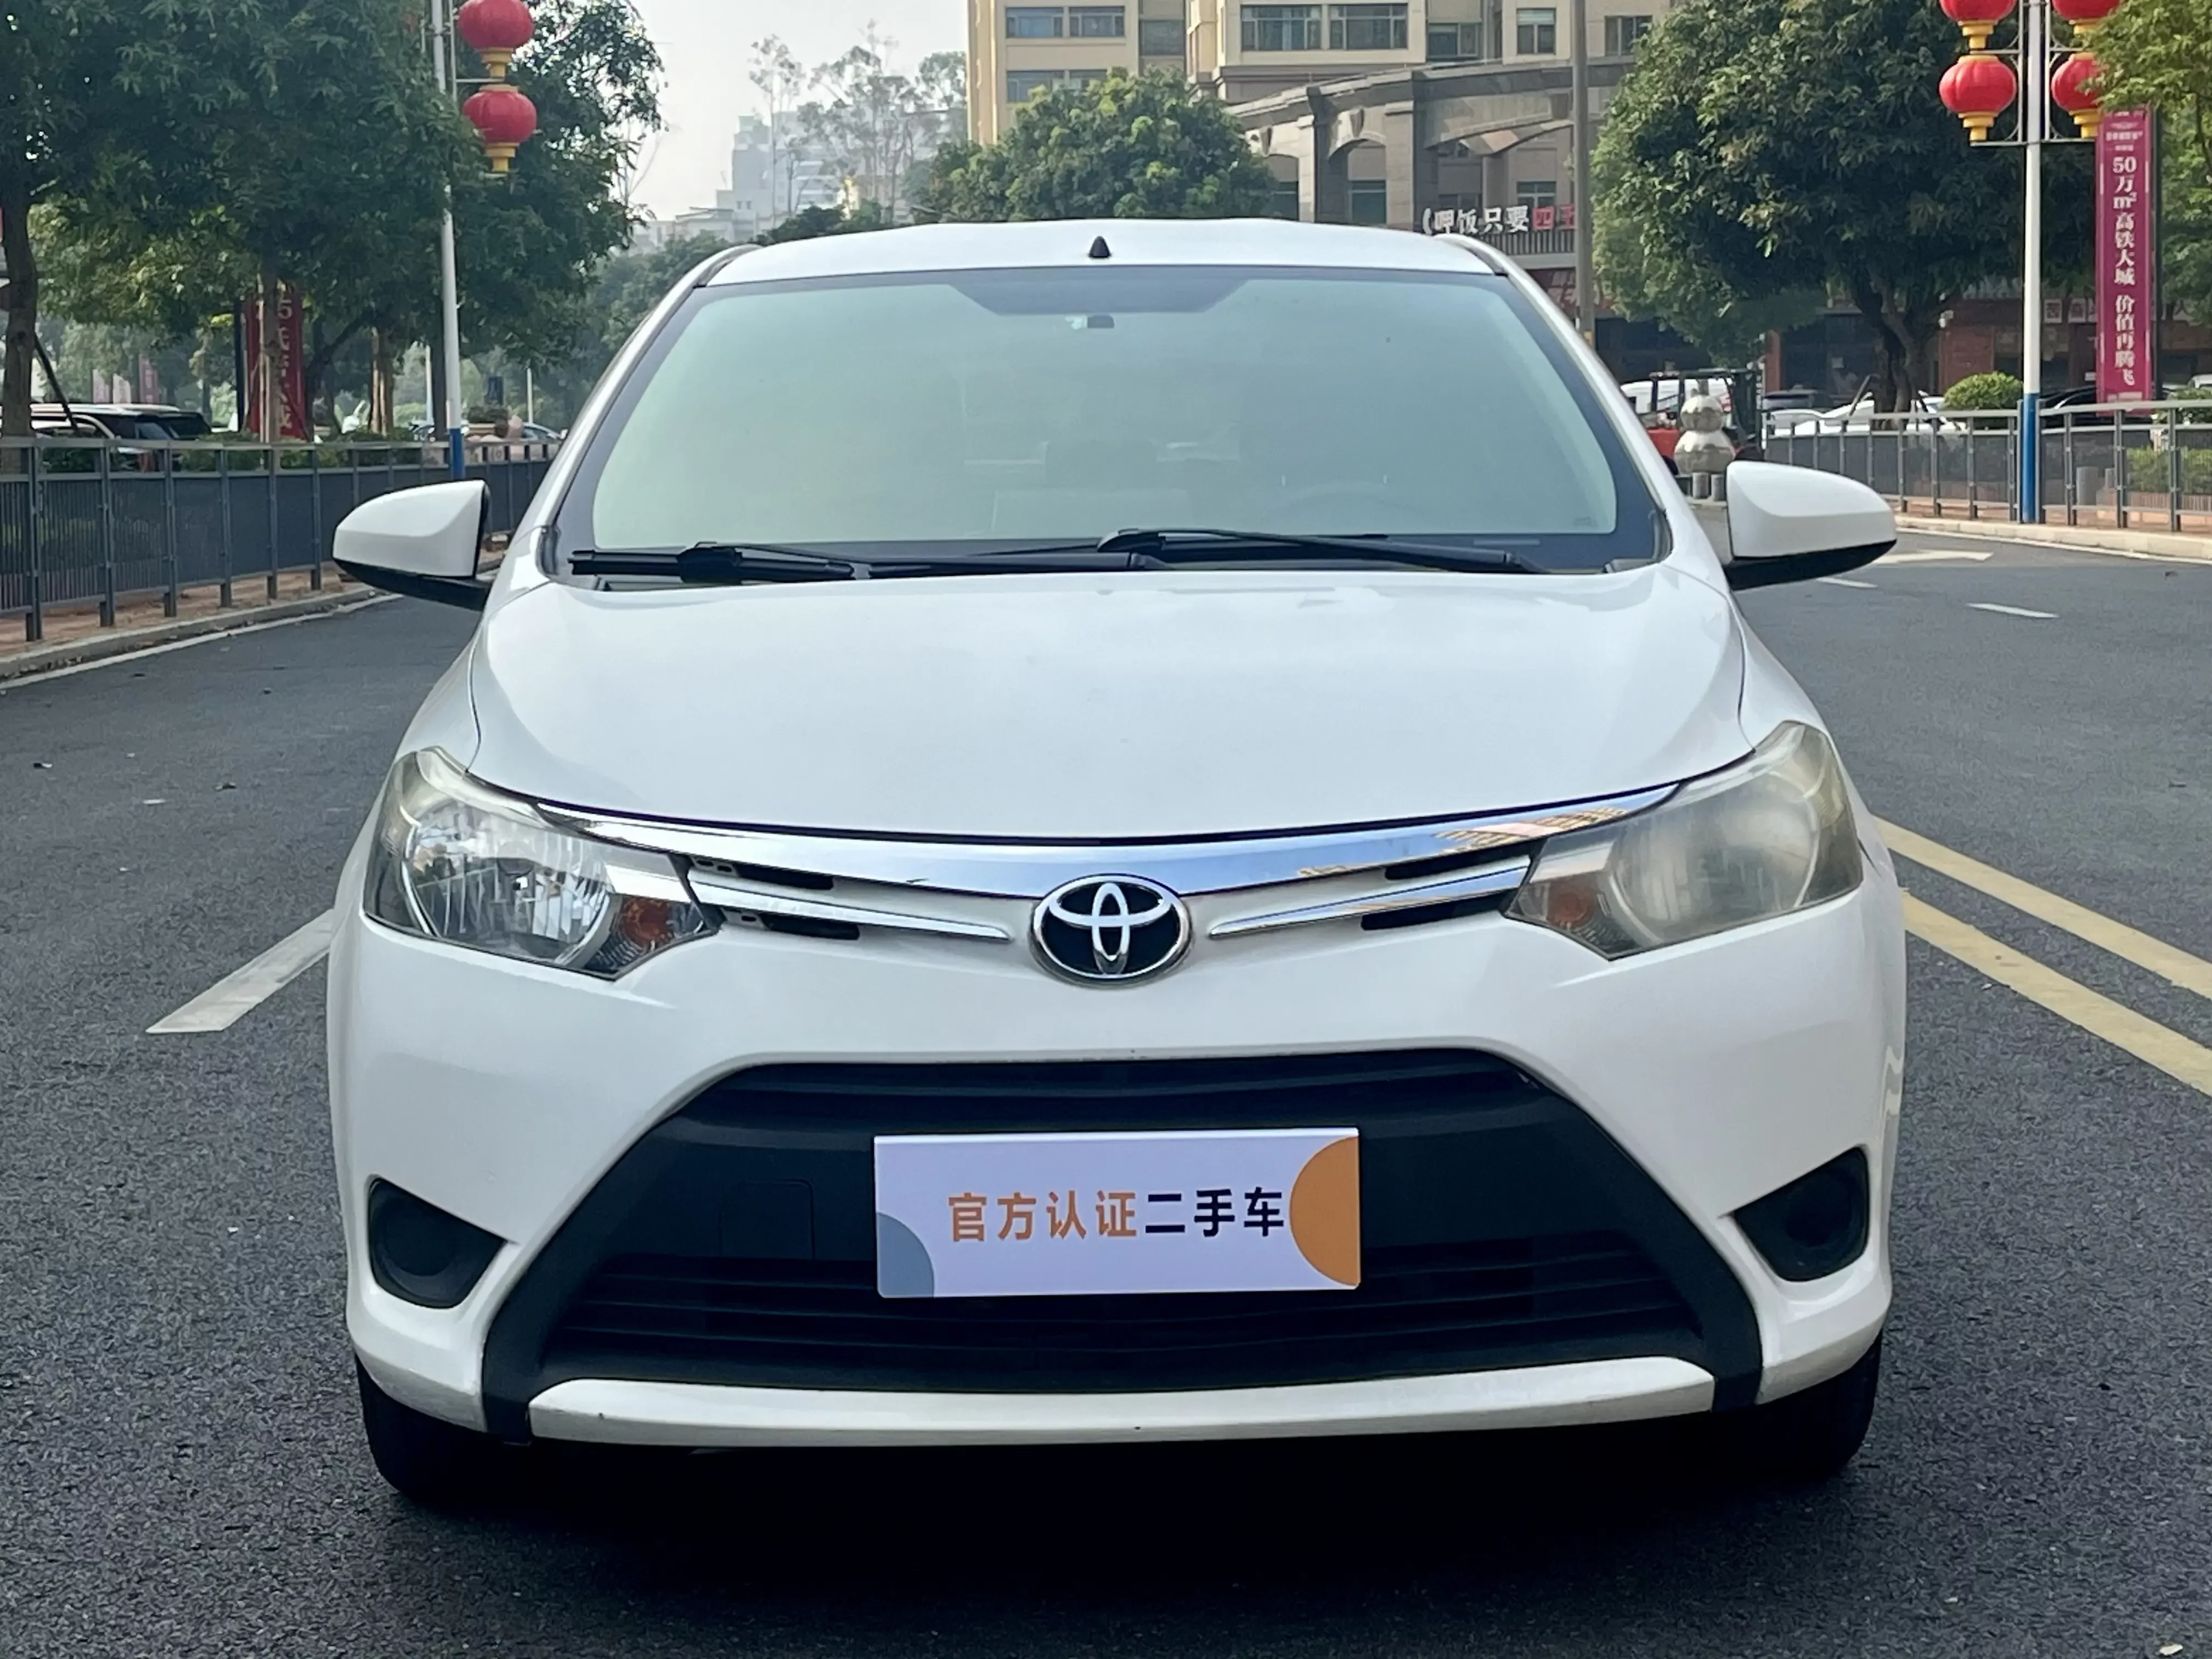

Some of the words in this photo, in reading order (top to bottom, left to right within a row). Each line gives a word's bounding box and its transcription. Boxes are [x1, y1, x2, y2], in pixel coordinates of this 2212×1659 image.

[947, 1187, 1285, 1243] 官方认证二手车
